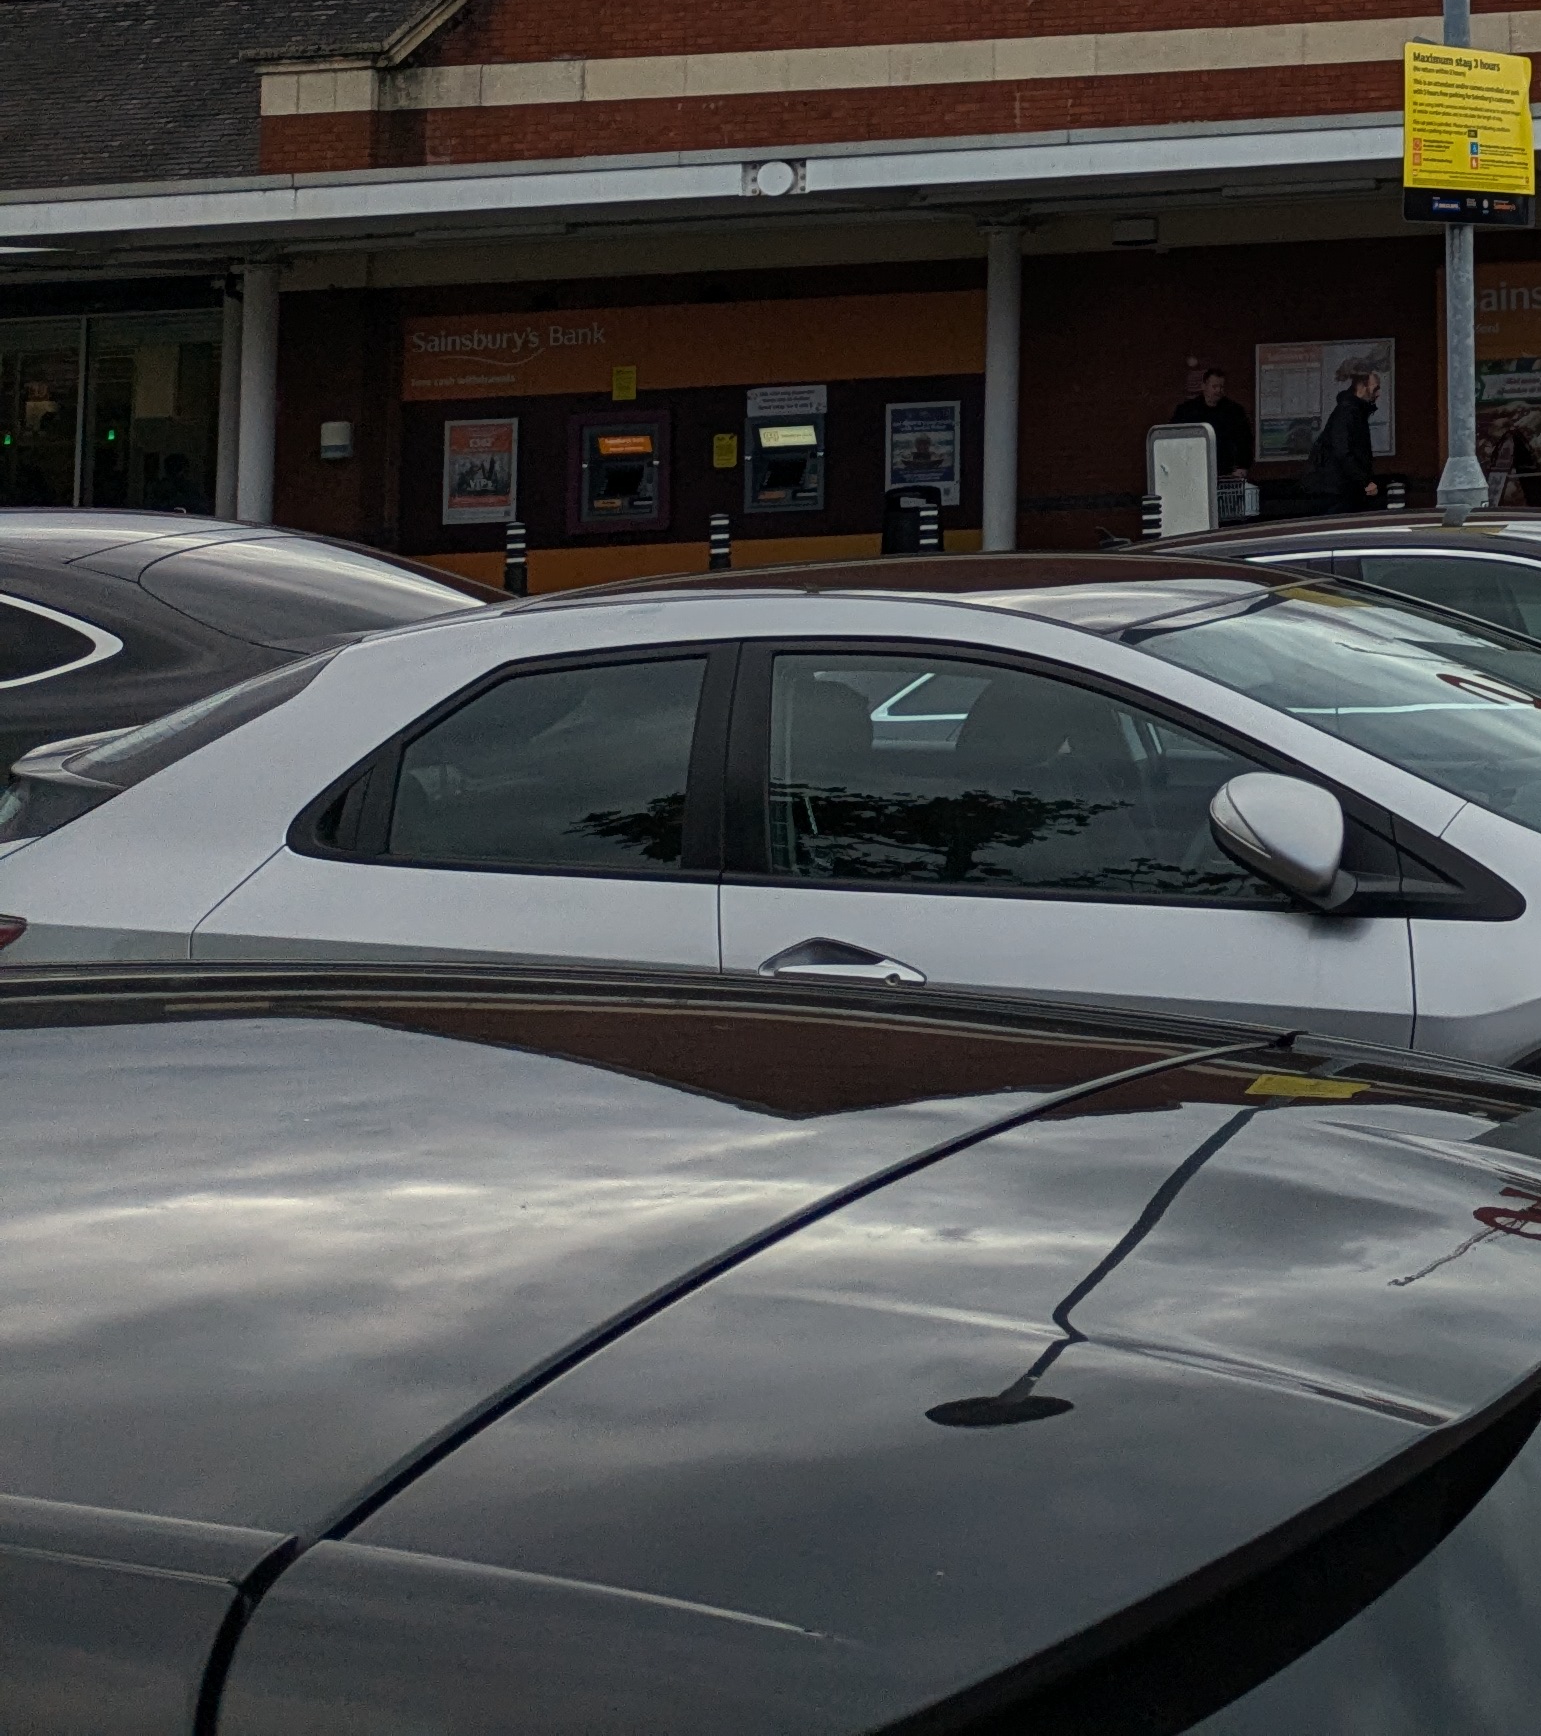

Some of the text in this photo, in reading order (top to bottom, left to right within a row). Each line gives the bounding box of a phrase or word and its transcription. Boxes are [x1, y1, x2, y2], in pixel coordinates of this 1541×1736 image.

[1412, 51, 1453, 66] Maximum
[1455, 57, 1472, 71] stay
[1480, 58, 1500, 71] hours
[412, 322, 606, 353] Sainsbury's Bank
